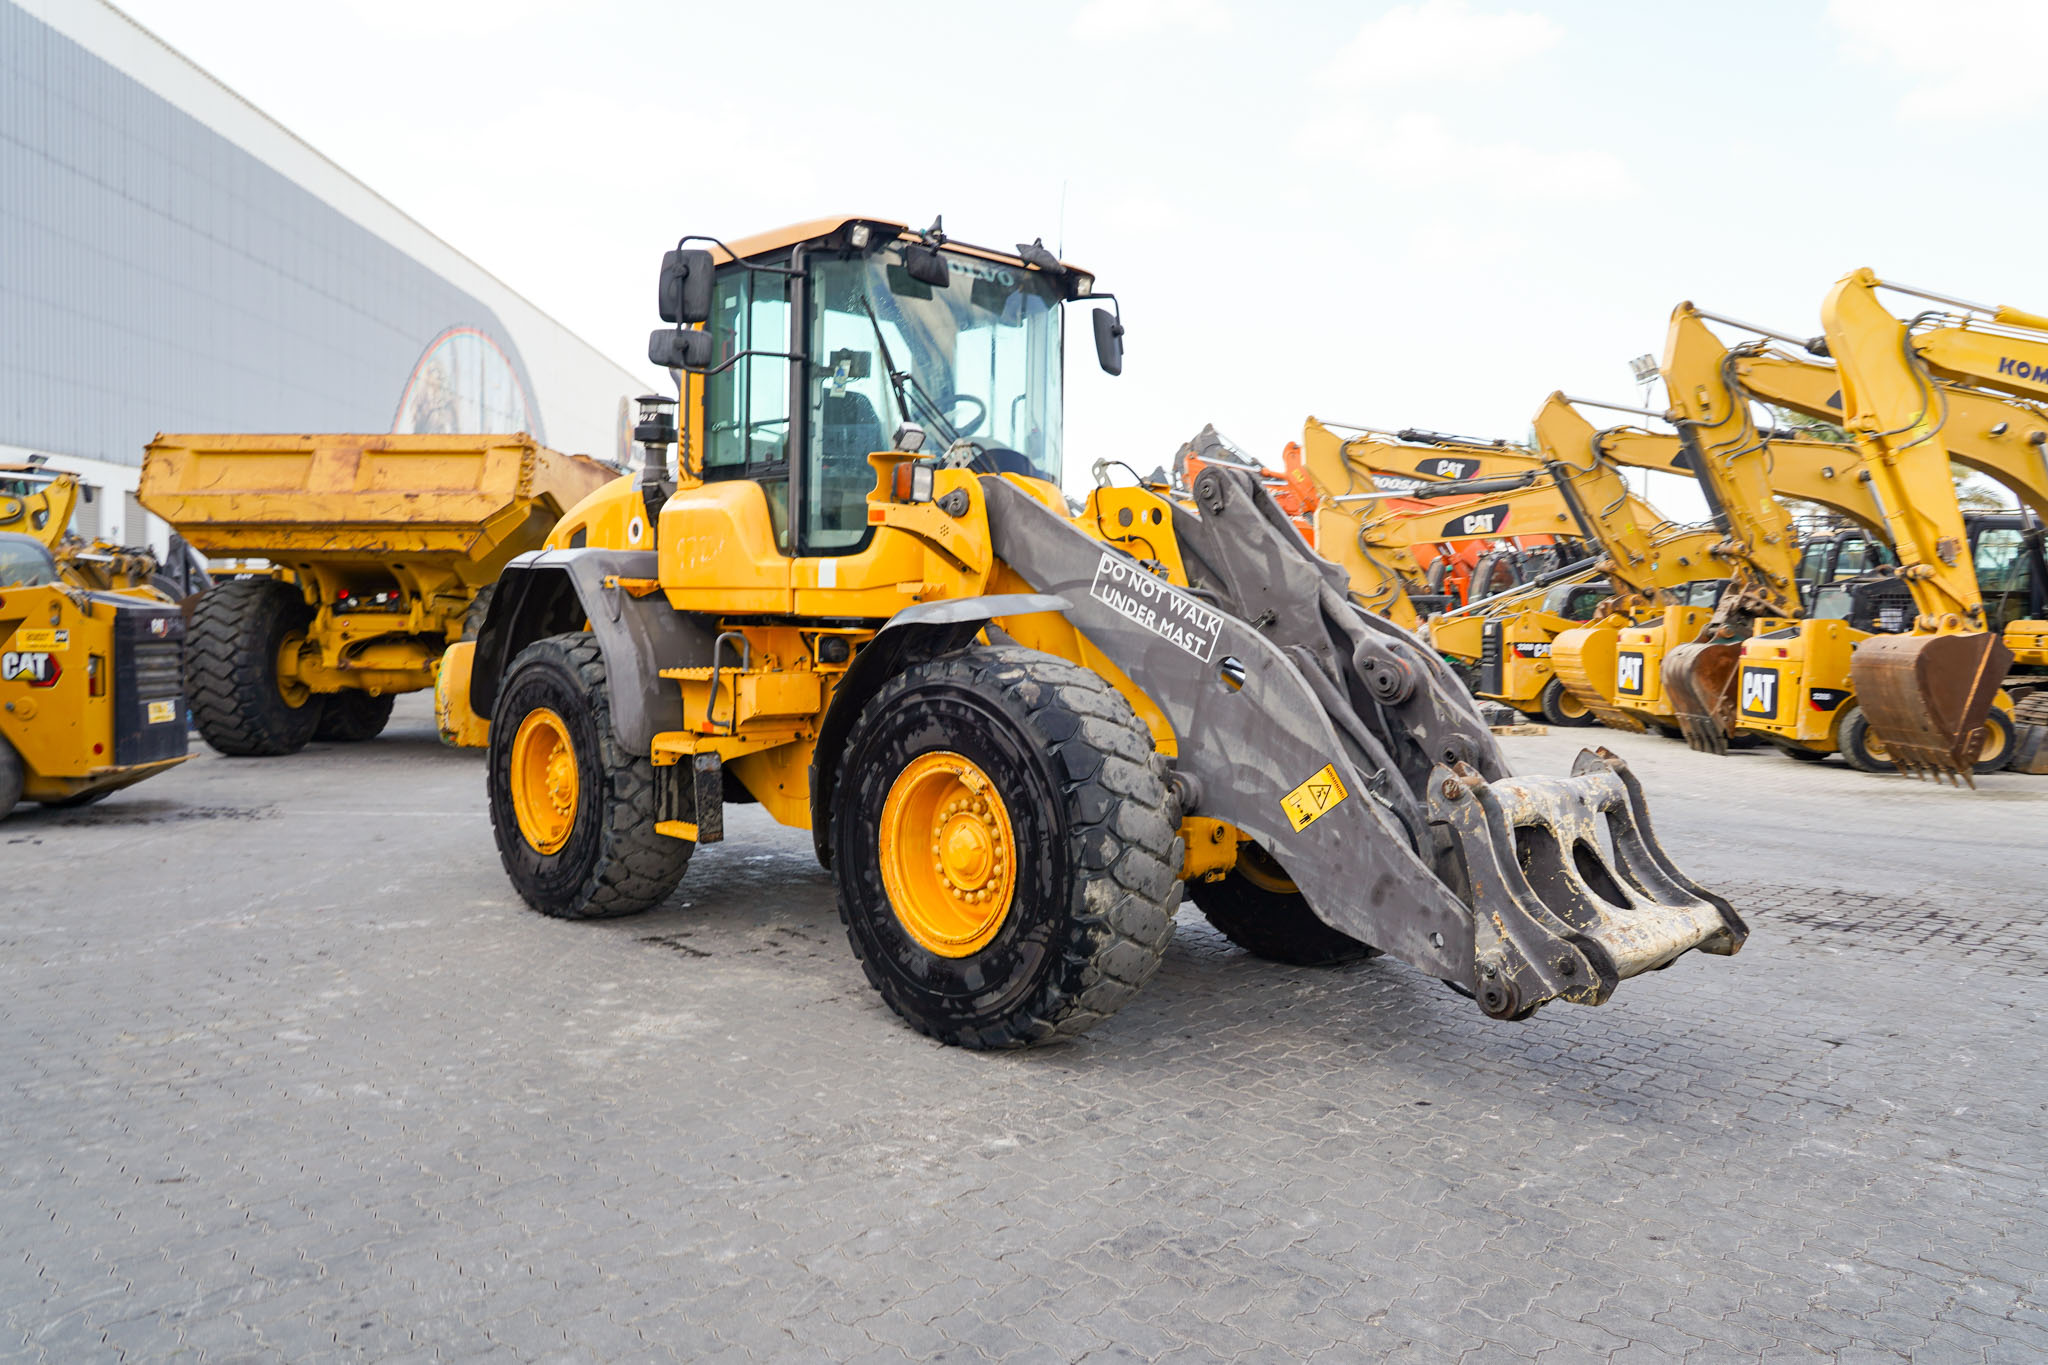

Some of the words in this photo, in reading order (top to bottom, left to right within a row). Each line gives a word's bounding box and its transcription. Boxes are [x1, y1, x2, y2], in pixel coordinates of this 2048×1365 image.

[947, 260, 1014, 287] OLVO
[1436, 459, 1465, 479] CAT
[1463, 513, 1495, 534] CAT
[1100, 559, 1126, 581] DO
[1128, 571, 1167, 603] NOT
[1170, 591, 1219, 635] WALK
[1102, 584, 1157, 630] UNDER
[1158, 617, 1207, 655] MAST
[2, 652, 49, 681] CAT
[1618, 655, 1643, 691] CAT
[1742, 671, 1776, 712] CAT
